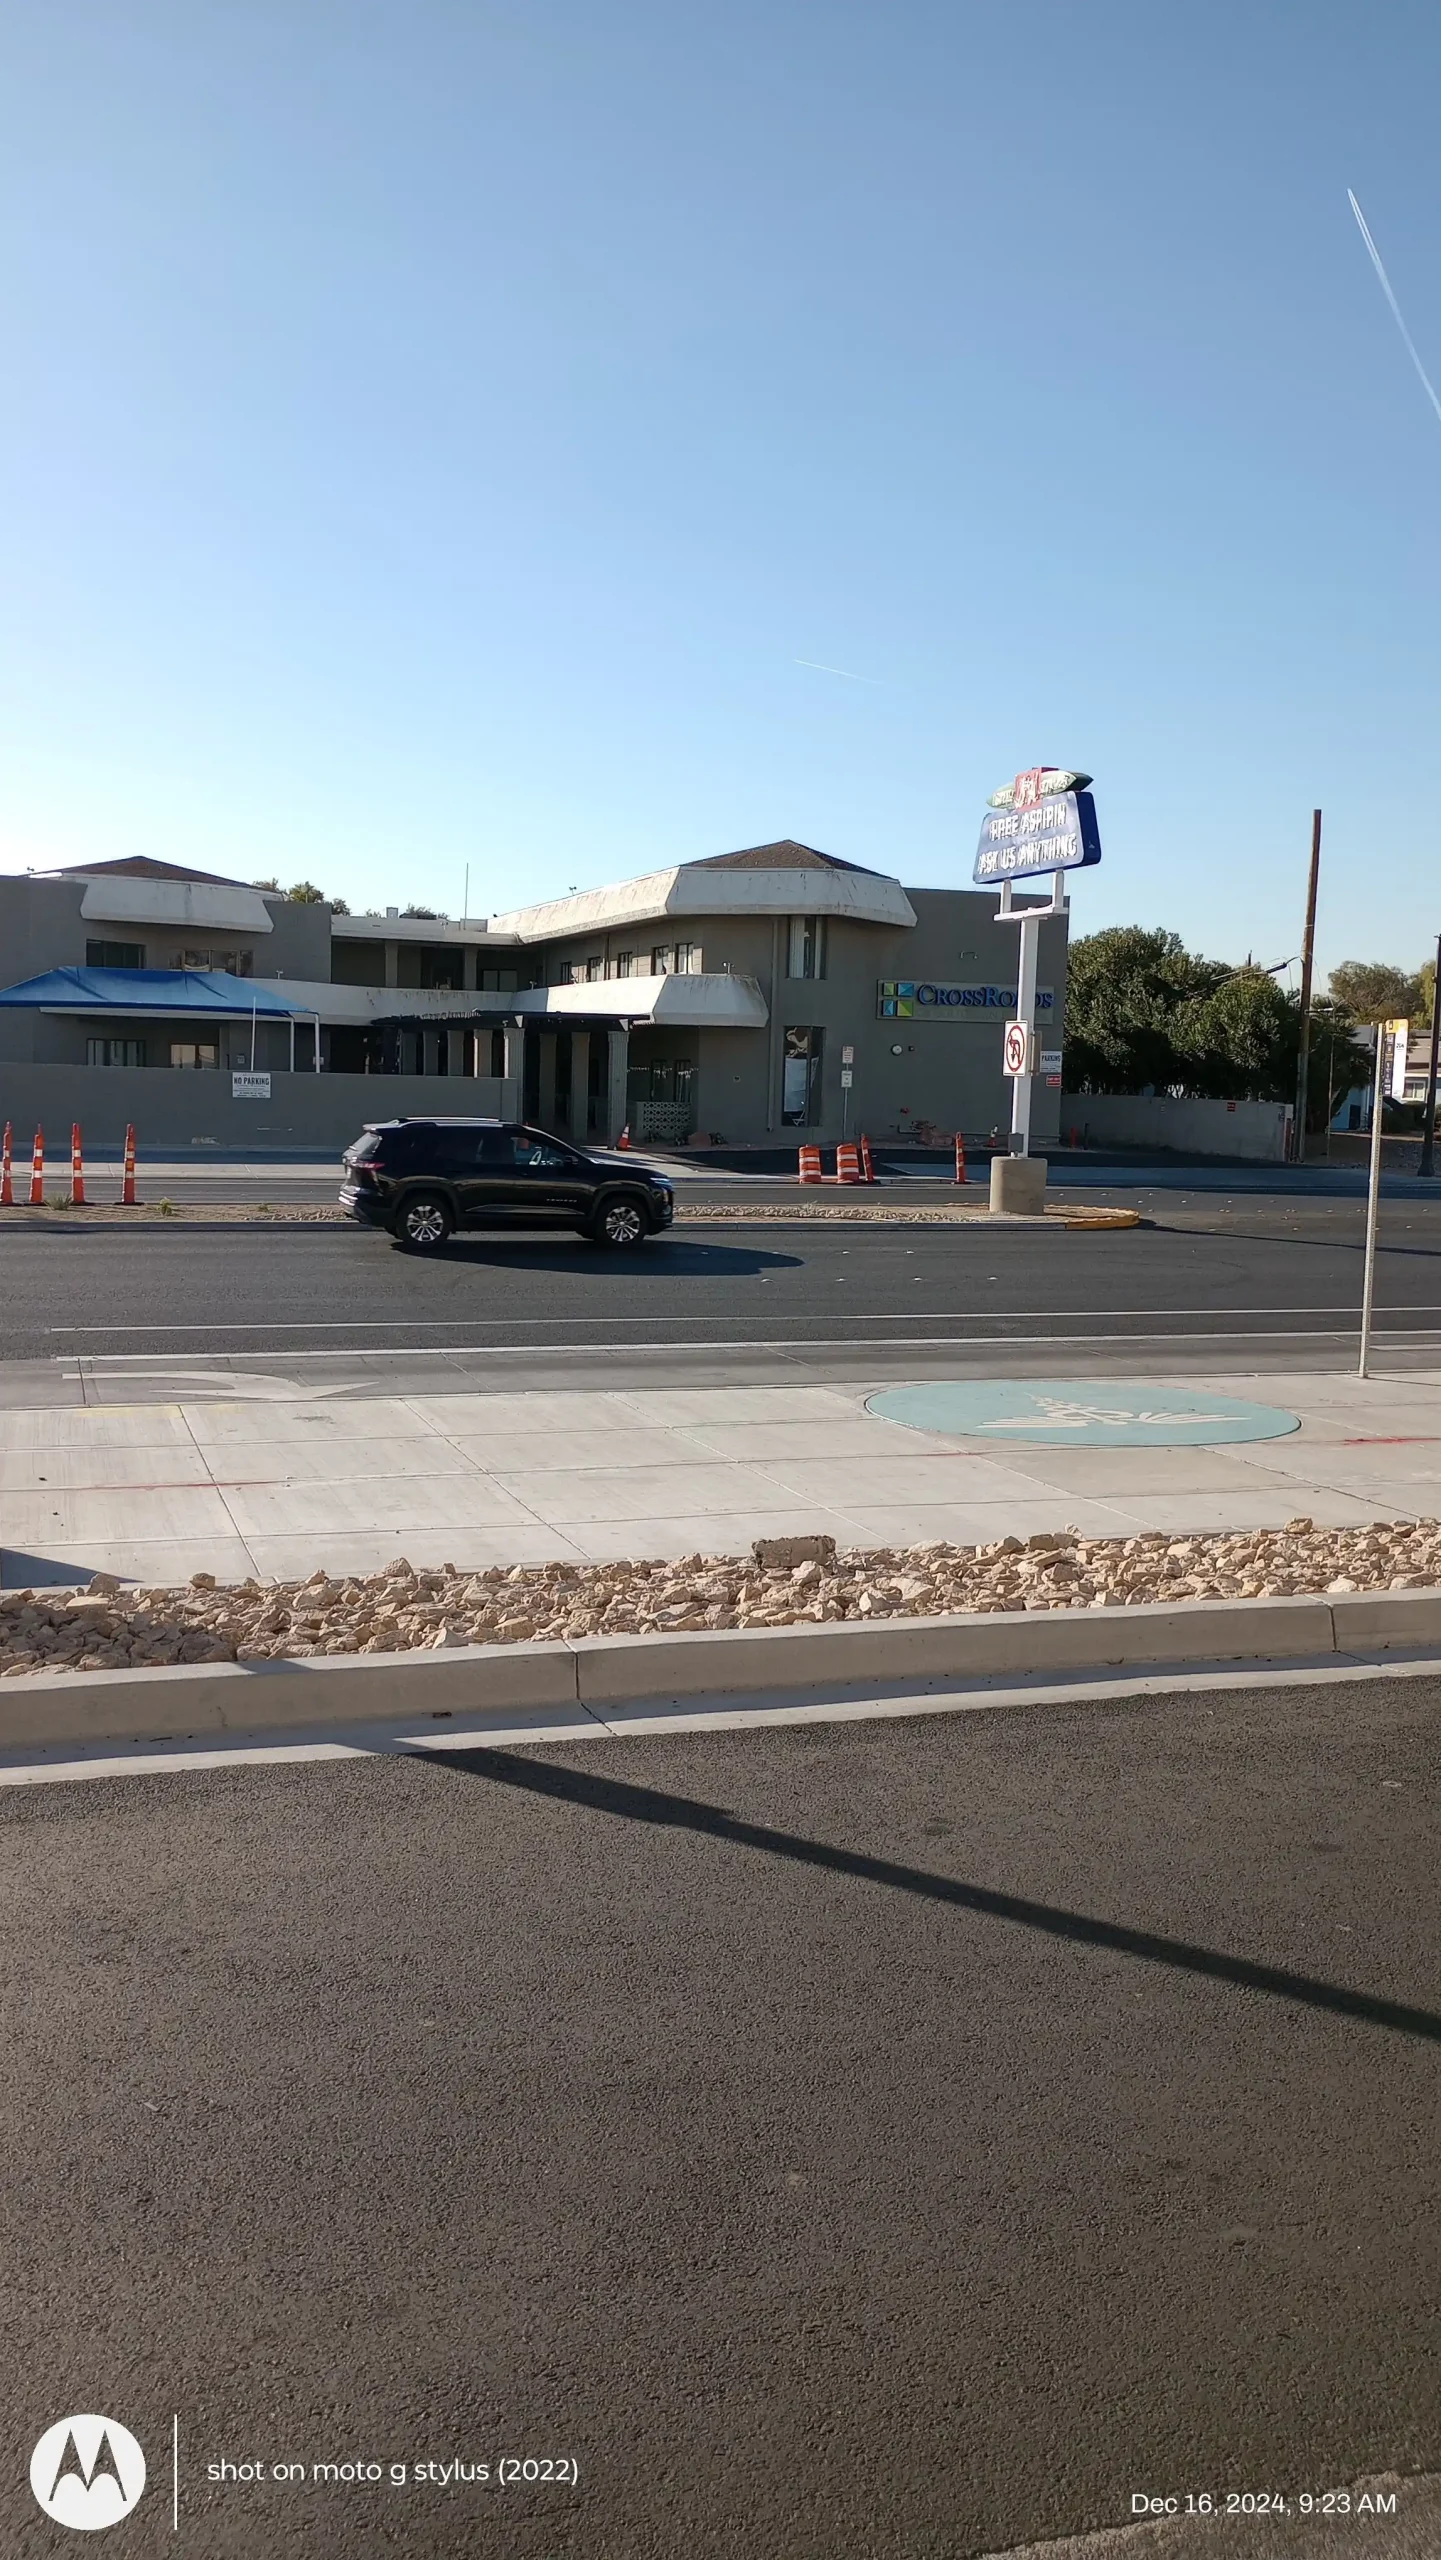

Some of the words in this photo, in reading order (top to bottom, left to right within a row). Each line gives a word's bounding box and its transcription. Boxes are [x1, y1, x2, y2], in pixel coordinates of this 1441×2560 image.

[989, 815, 1019, 841] FREE
[1020, 803, 1067, 835] ASPIRIN
[978, 850, 999, 874] ASK
[1000, 846, 1018, 870] US
[1018, 833, 1078, 866] ANYTHING
[917, 984, 1055, 1008] CROSSRODS
[243, 1077, 270, 1085] PARKING
